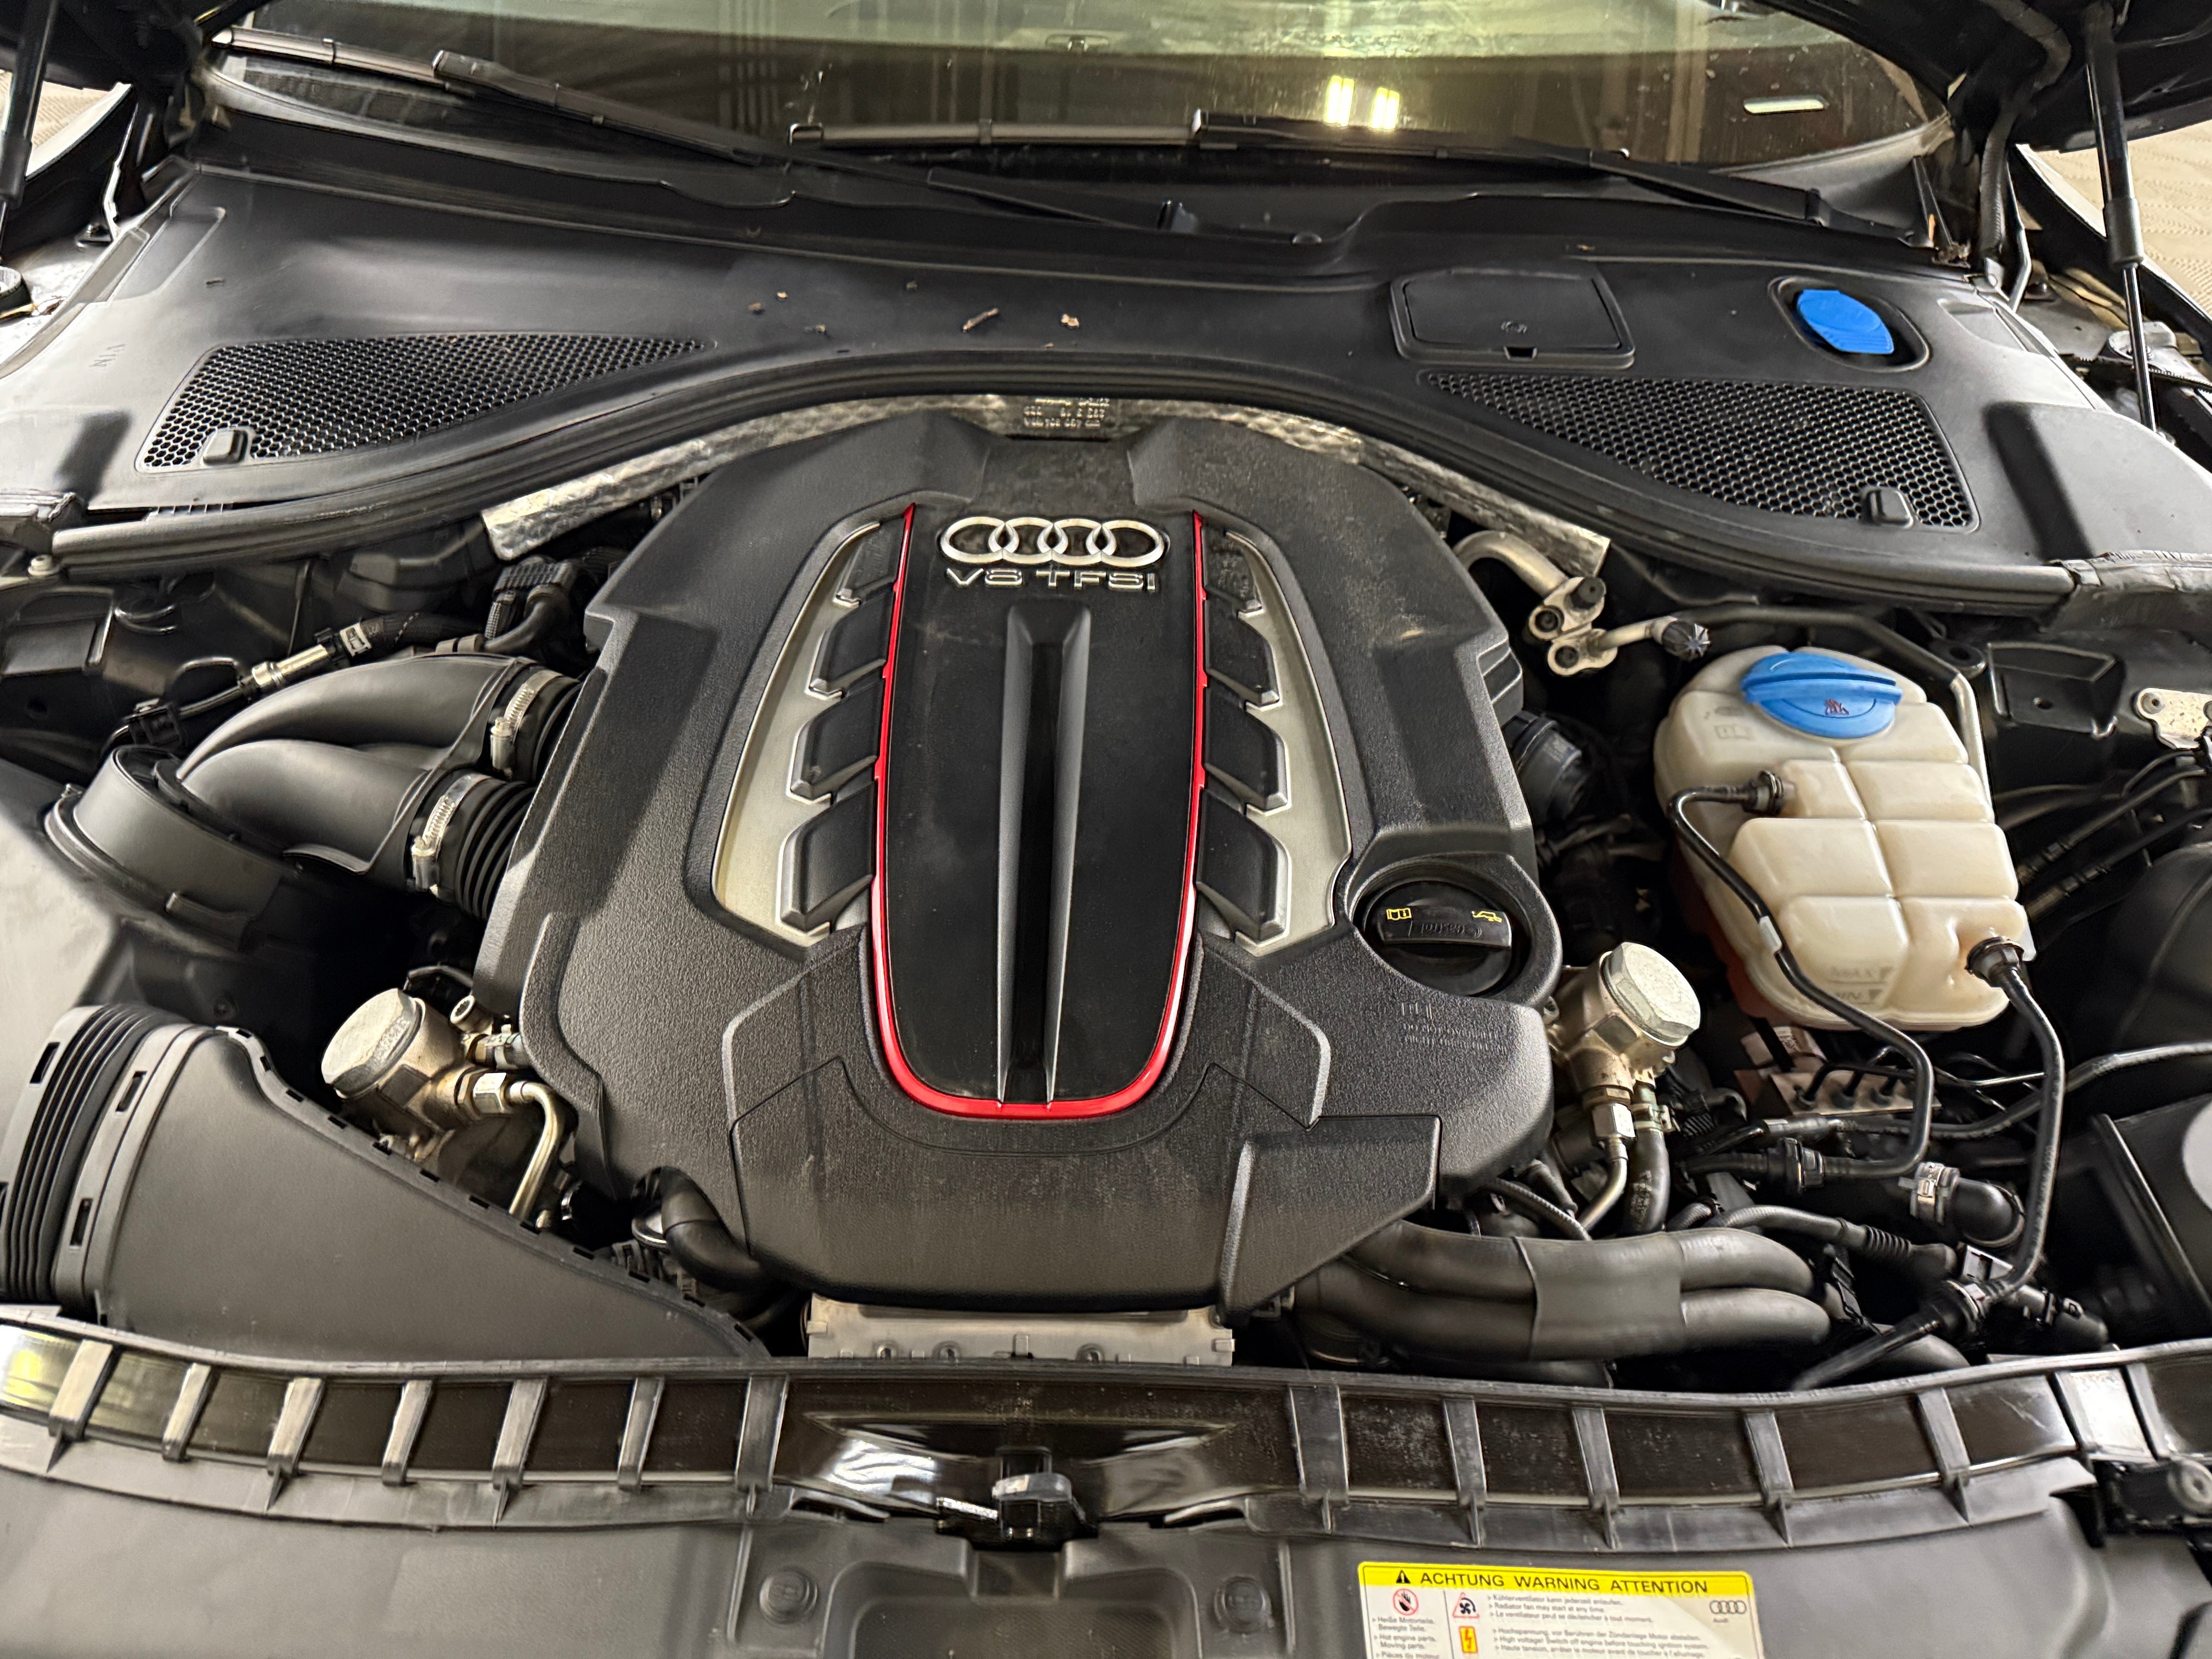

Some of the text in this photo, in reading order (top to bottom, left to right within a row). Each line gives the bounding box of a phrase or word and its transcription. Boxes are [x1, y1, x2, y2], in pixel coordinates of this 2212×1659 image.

[946, 567, 1157, 593] V8 TFSI
[1420, 1573, 1708, 1593] ACHTUNG WARNING ATTENTION
